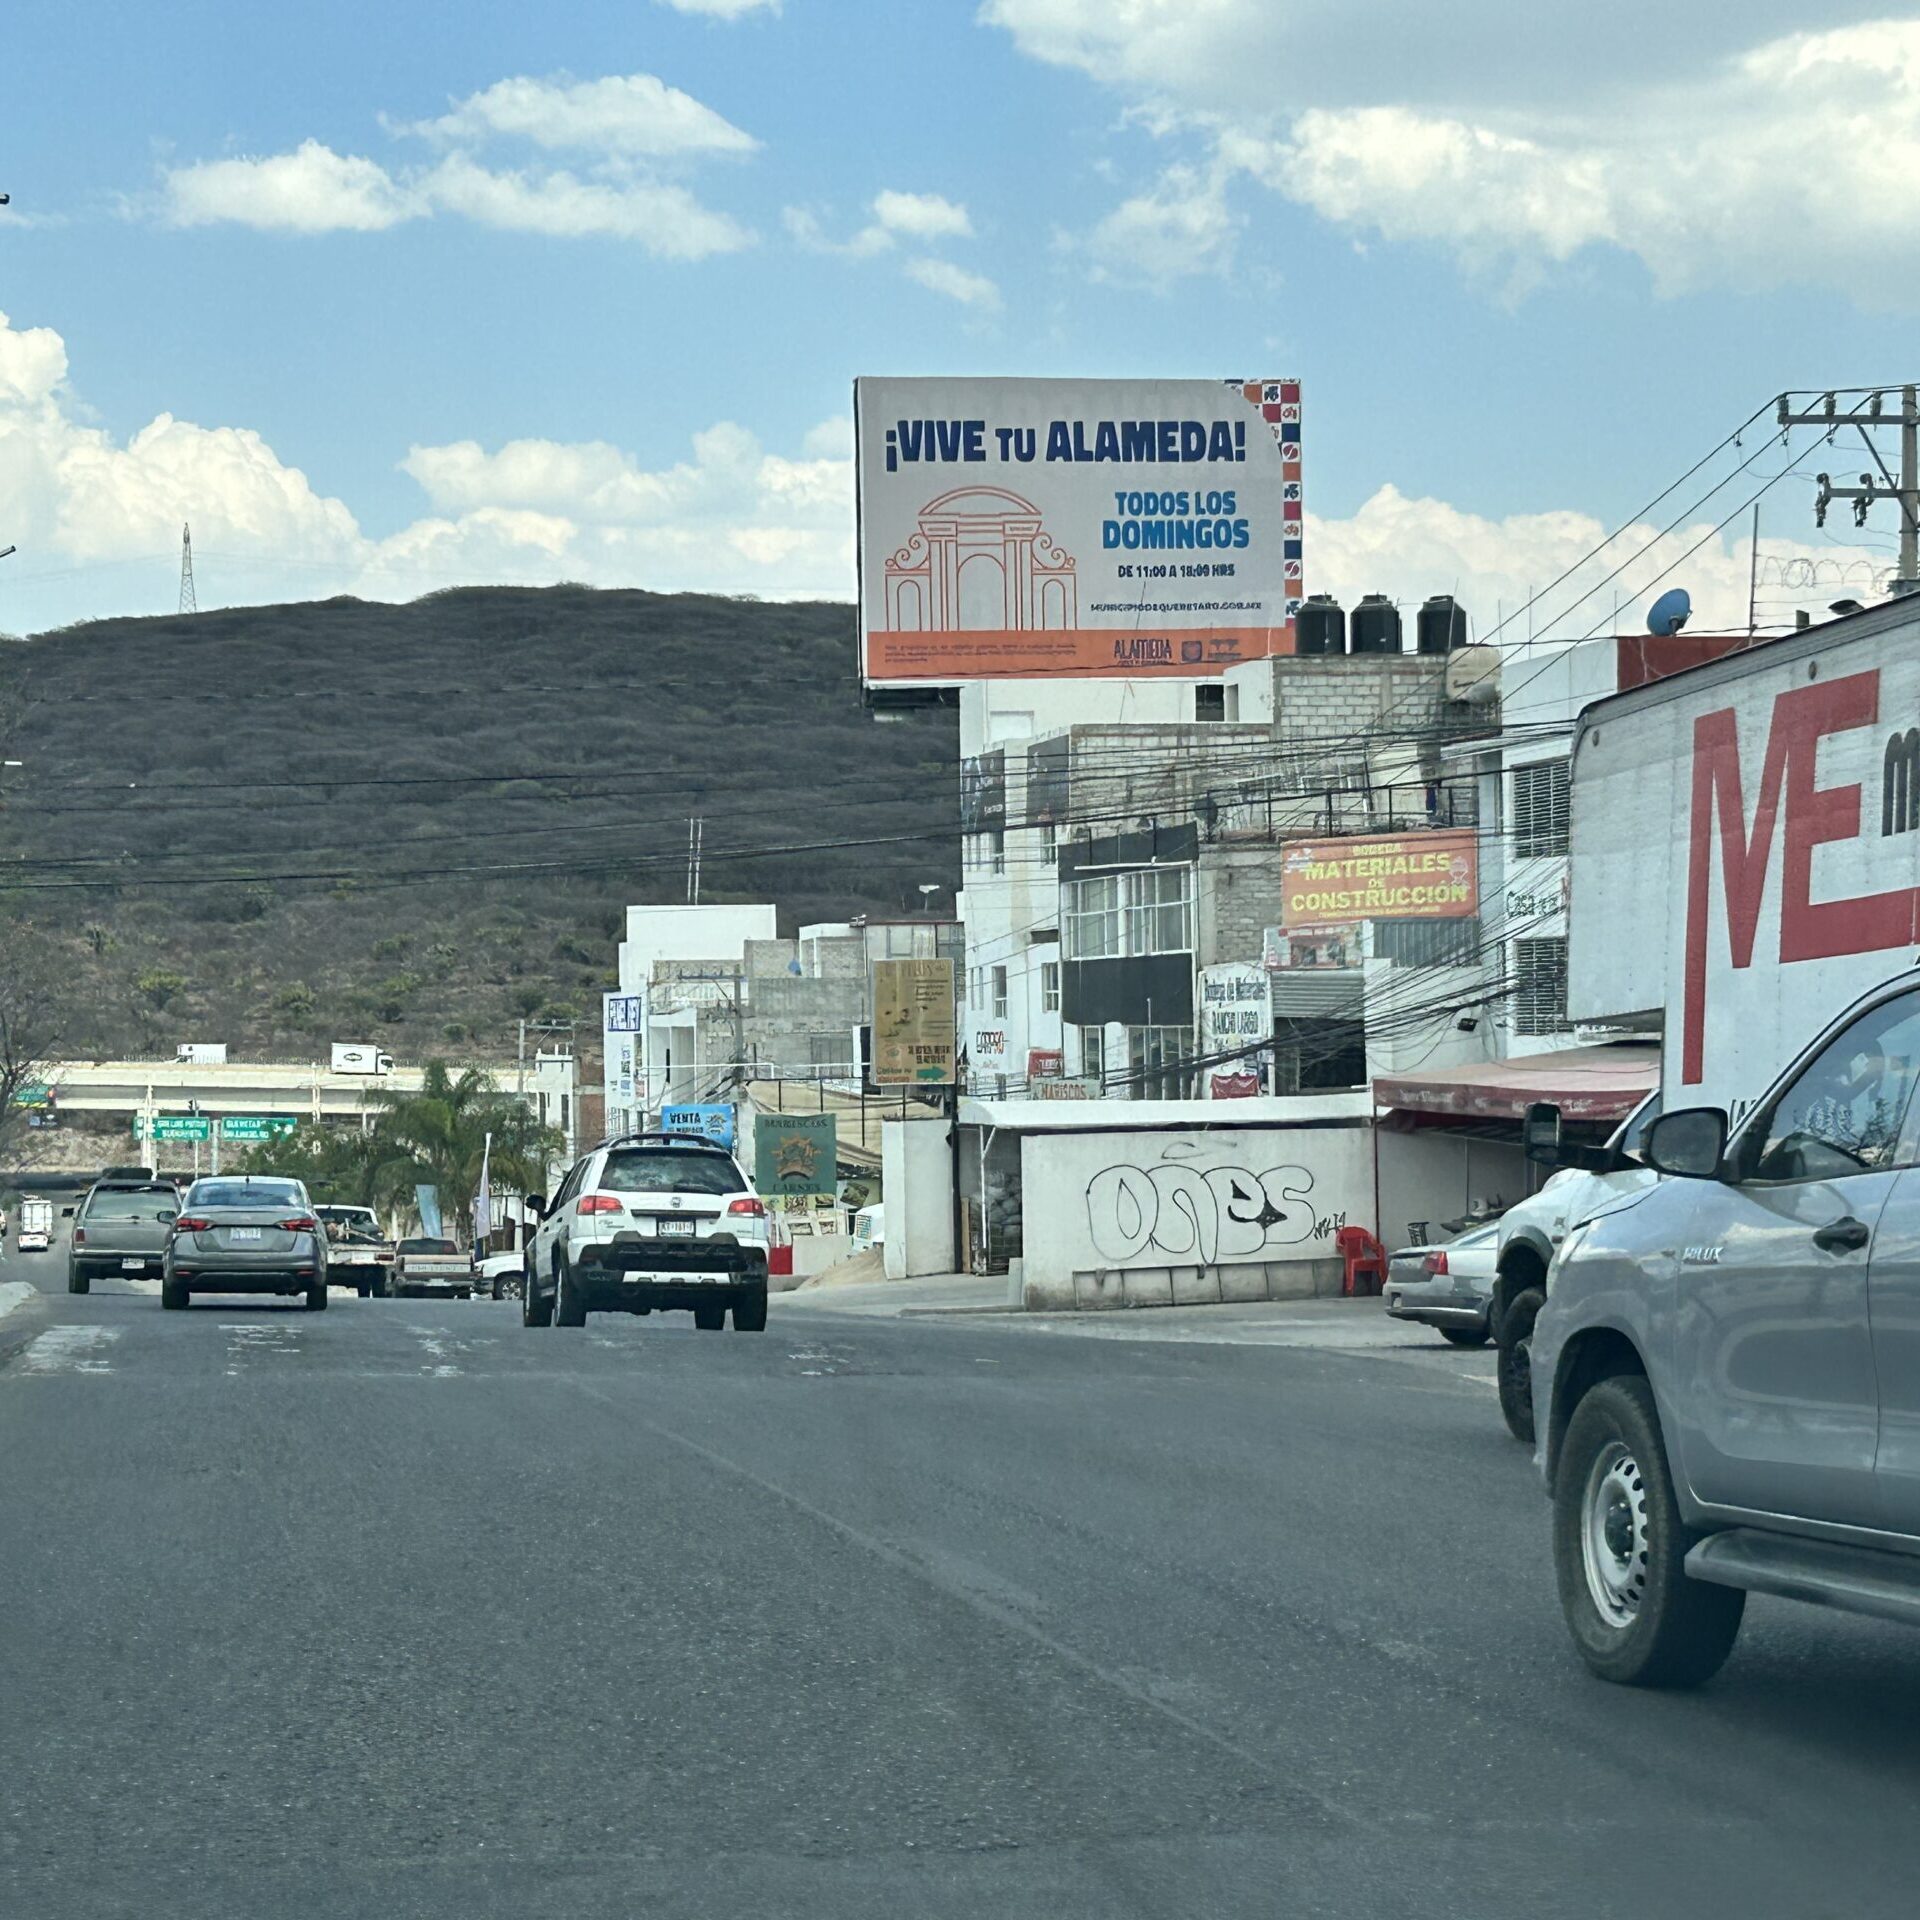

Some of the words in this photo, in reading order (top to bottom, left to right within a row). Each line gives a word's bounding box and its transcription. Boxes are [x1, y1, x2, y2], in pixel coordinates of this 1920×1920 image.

[886, 420, 986, 472] ¡VIVE
[995, 428, 1035, 462] TU
[1046, 421, 1246, 462] ALAMEDA!
[1115, 491, 1189, 516] TODOS
[1195, 491, 1236, 515] LOS
[1102, 519, 1250, 549] DOMINGOS
[1118, 565, 1133, 577] DE
[1136, 565, 1167, 577] 11:00
[1169, 565, 1177, 577] A
[1304, 853, 1450, 880] MATERIALES
[1291, 881, 1469, 912] CONSTRUCCIÓN
